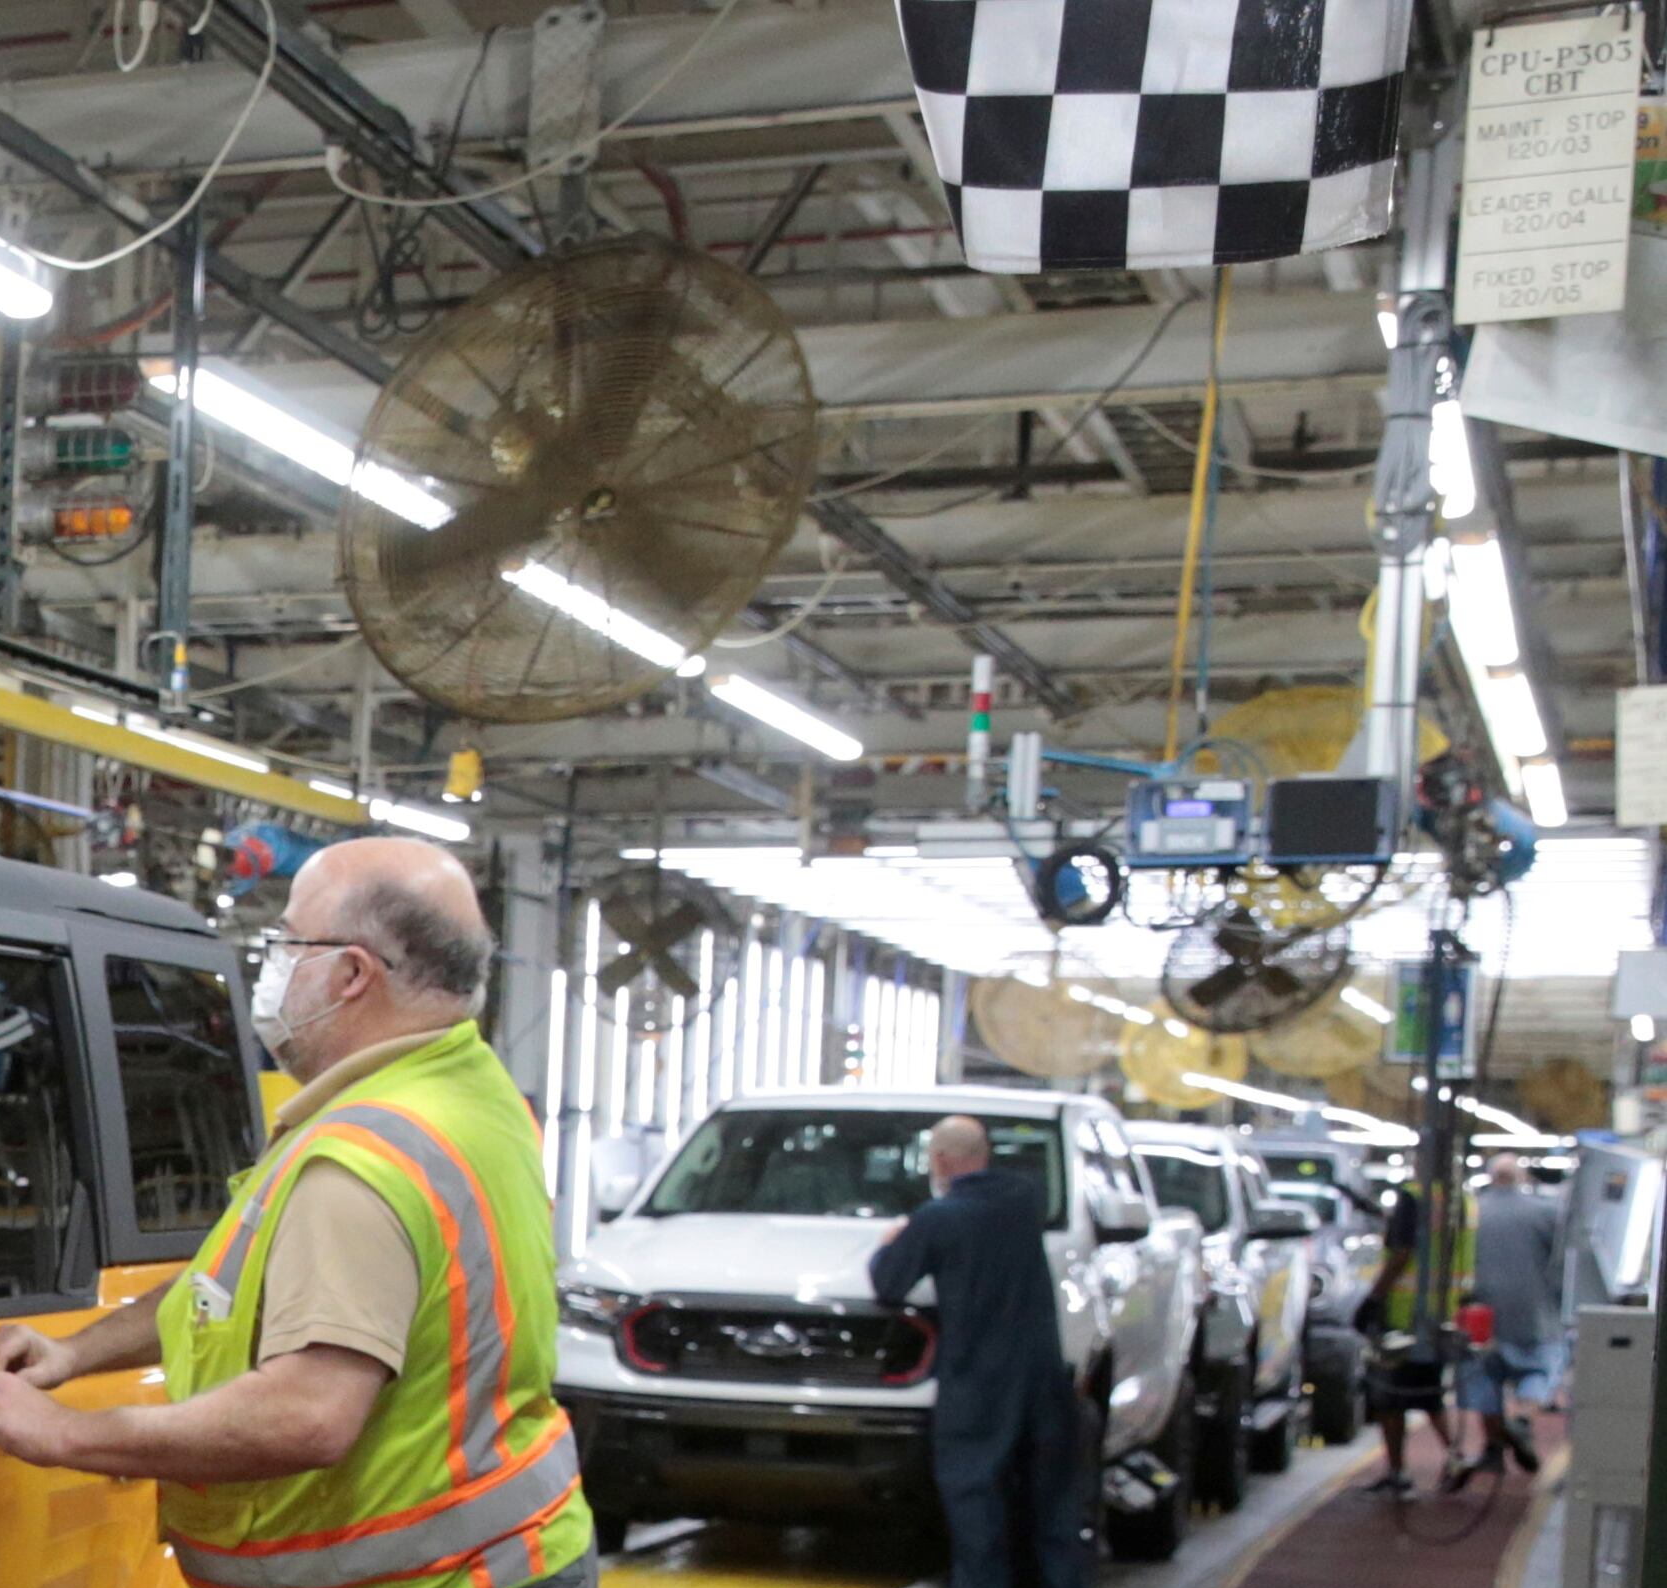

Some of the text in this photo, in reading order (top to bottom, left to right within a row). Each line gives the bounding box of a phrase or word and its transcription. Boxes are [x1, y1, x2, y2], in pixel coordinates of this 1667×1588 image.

[1480, 40, 1632, 77] CPU-P303
[1525, 70, 1584, 96] CBT
[1567, 110, 1626, 133] STOP
[1466, 186, 1626, 217] LEADER CALL
[1473, 260, 1611, 290] FIXED STOP
